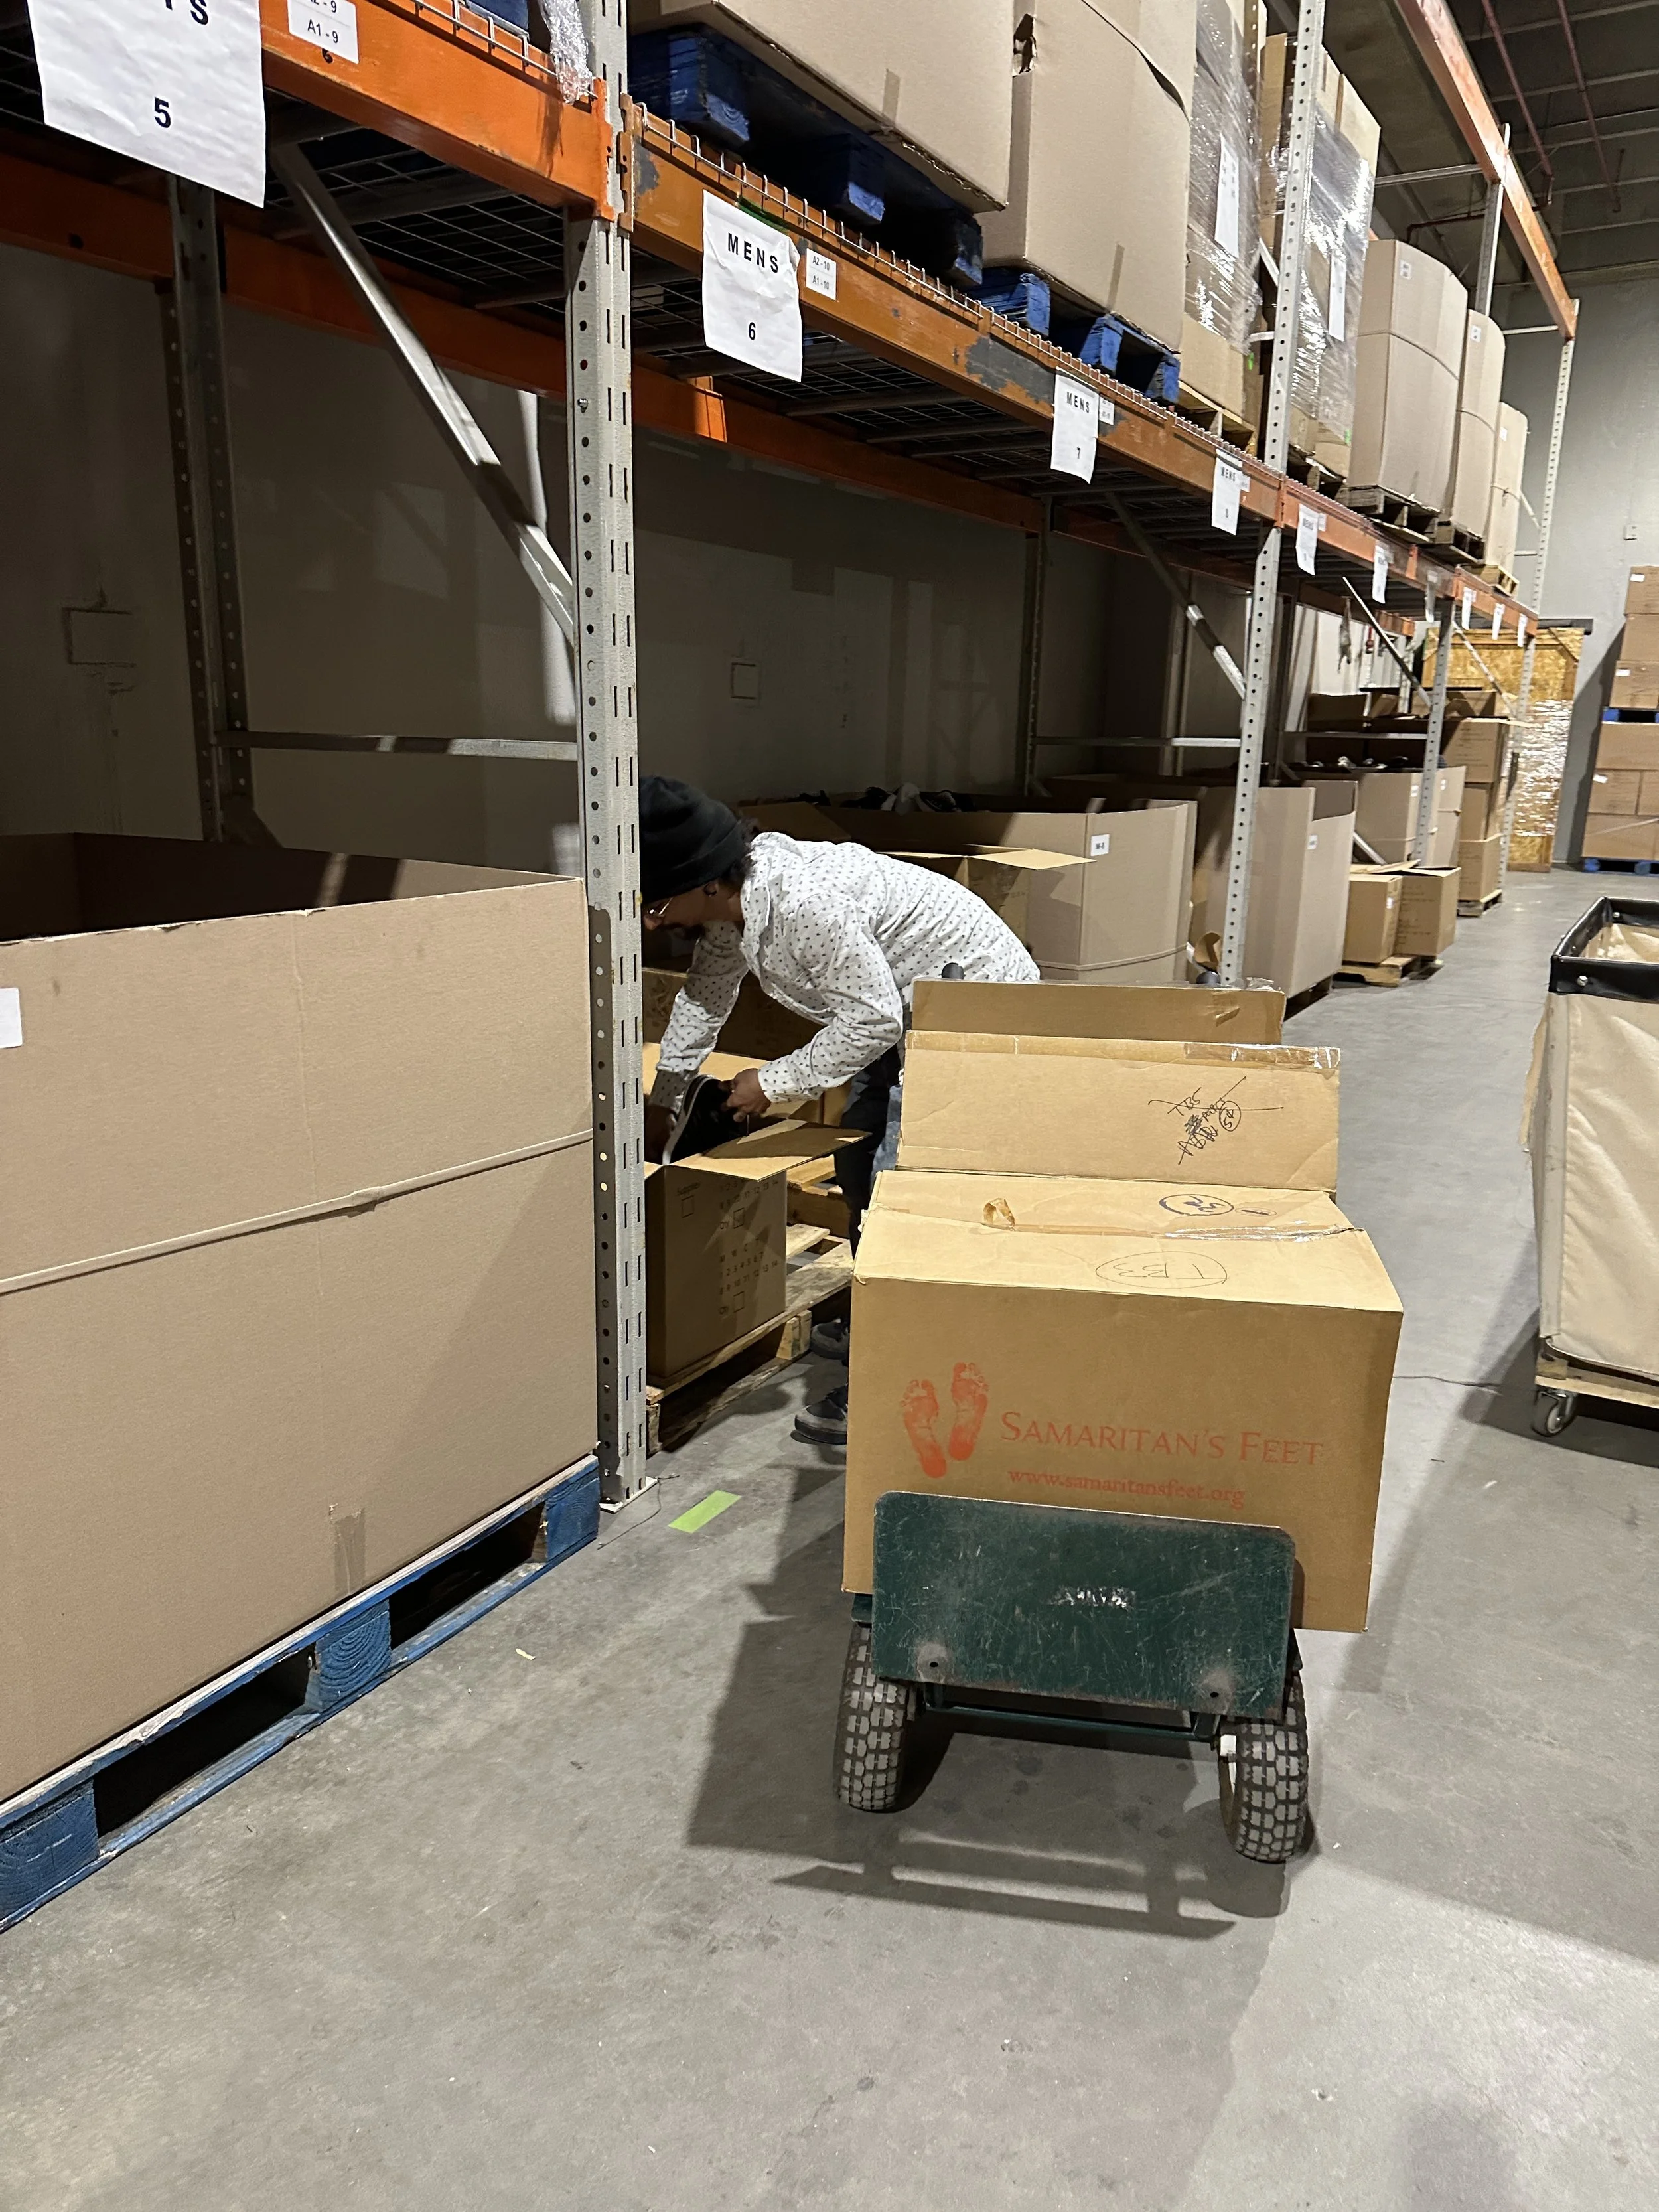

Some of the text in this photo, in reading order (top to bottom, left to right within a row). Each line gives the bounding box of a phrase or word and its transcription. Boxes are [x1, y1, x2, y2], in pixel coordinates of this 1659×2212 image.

[154, 96, 171, 129] 5
[727, 232, 779, 274] MENS
[748, 321, 757, 340] 6
[1066, 390, 1090, 414] MENS
[1076, 446, 1082, 460] 7
[1000, 1411, 1325, 1466] SAMARITAN'S FEET
[1007, 1469, 1246, 1511] www.samaritansfeet.org
